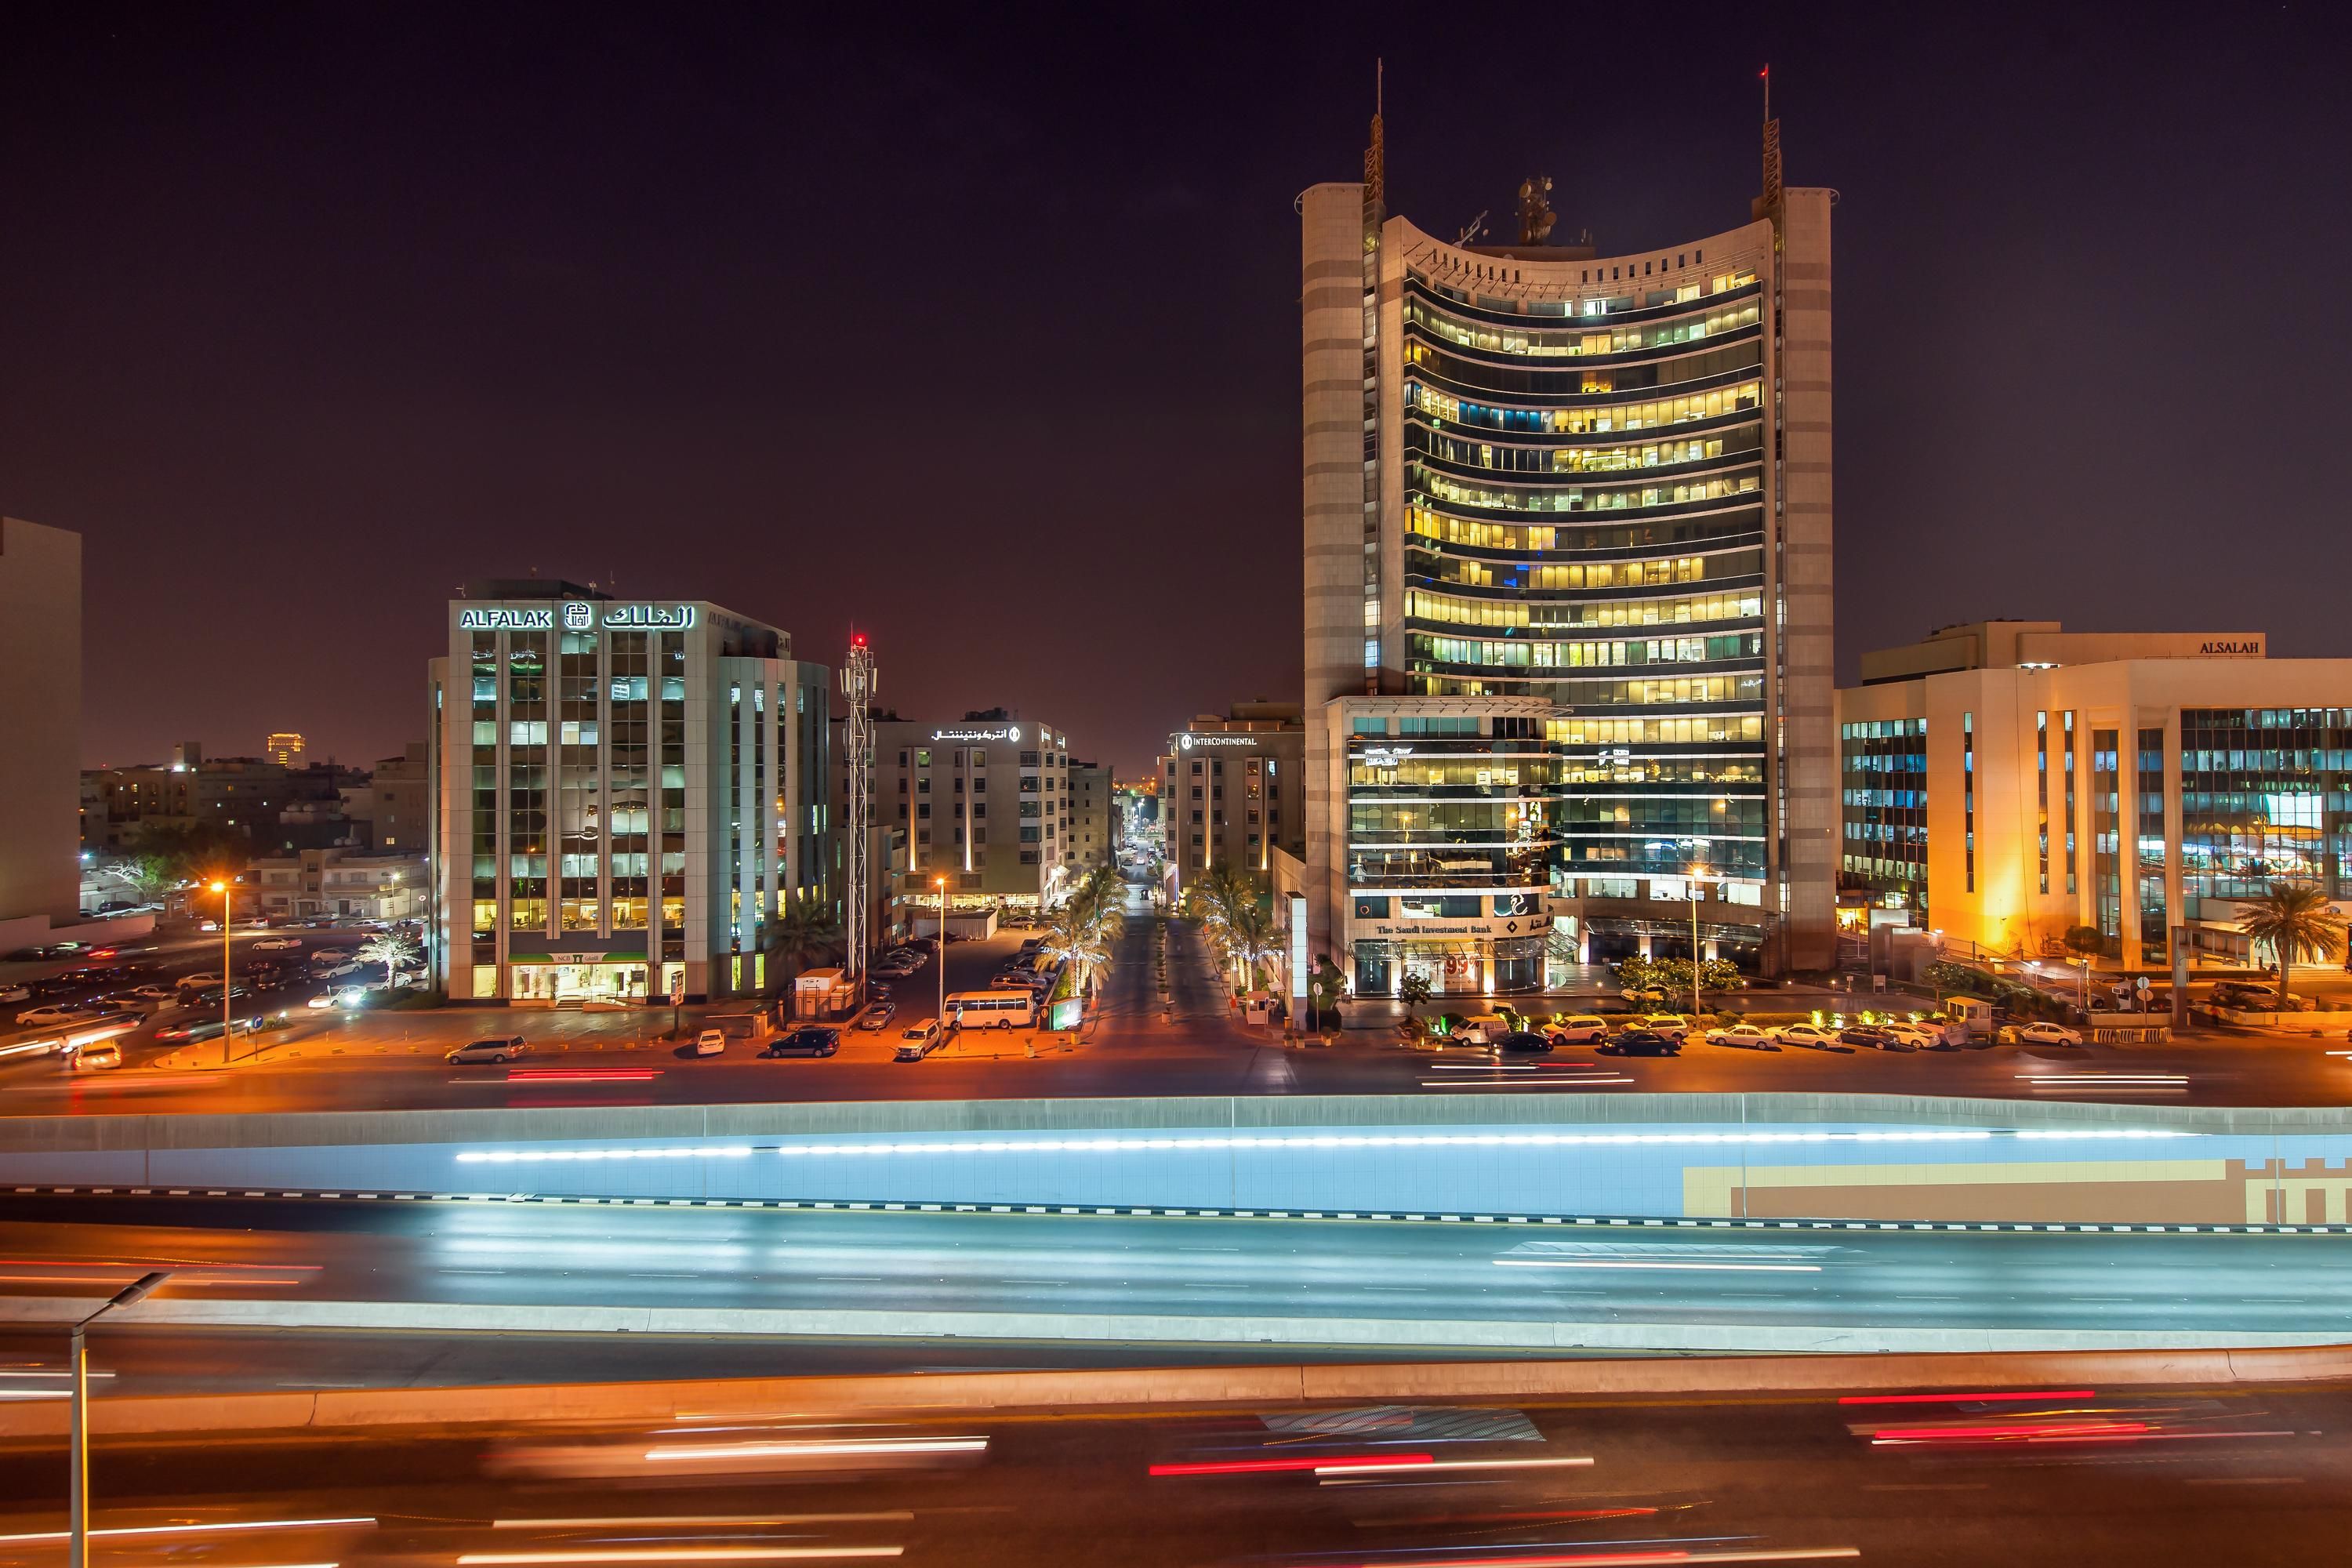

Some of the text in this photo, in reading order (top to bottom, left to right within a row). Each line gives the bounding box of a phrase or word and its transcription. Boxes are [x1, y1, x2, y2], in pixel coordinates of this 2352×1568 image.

[460, 610, 552, 626] ALFALAK
[602, 605, 695, 628] الفلك
[2200, 642, 2259, 654] ALSALAH
[1396, 925, 1420, 934] Saudi
[1421, 925, 1468, 934] Investment
